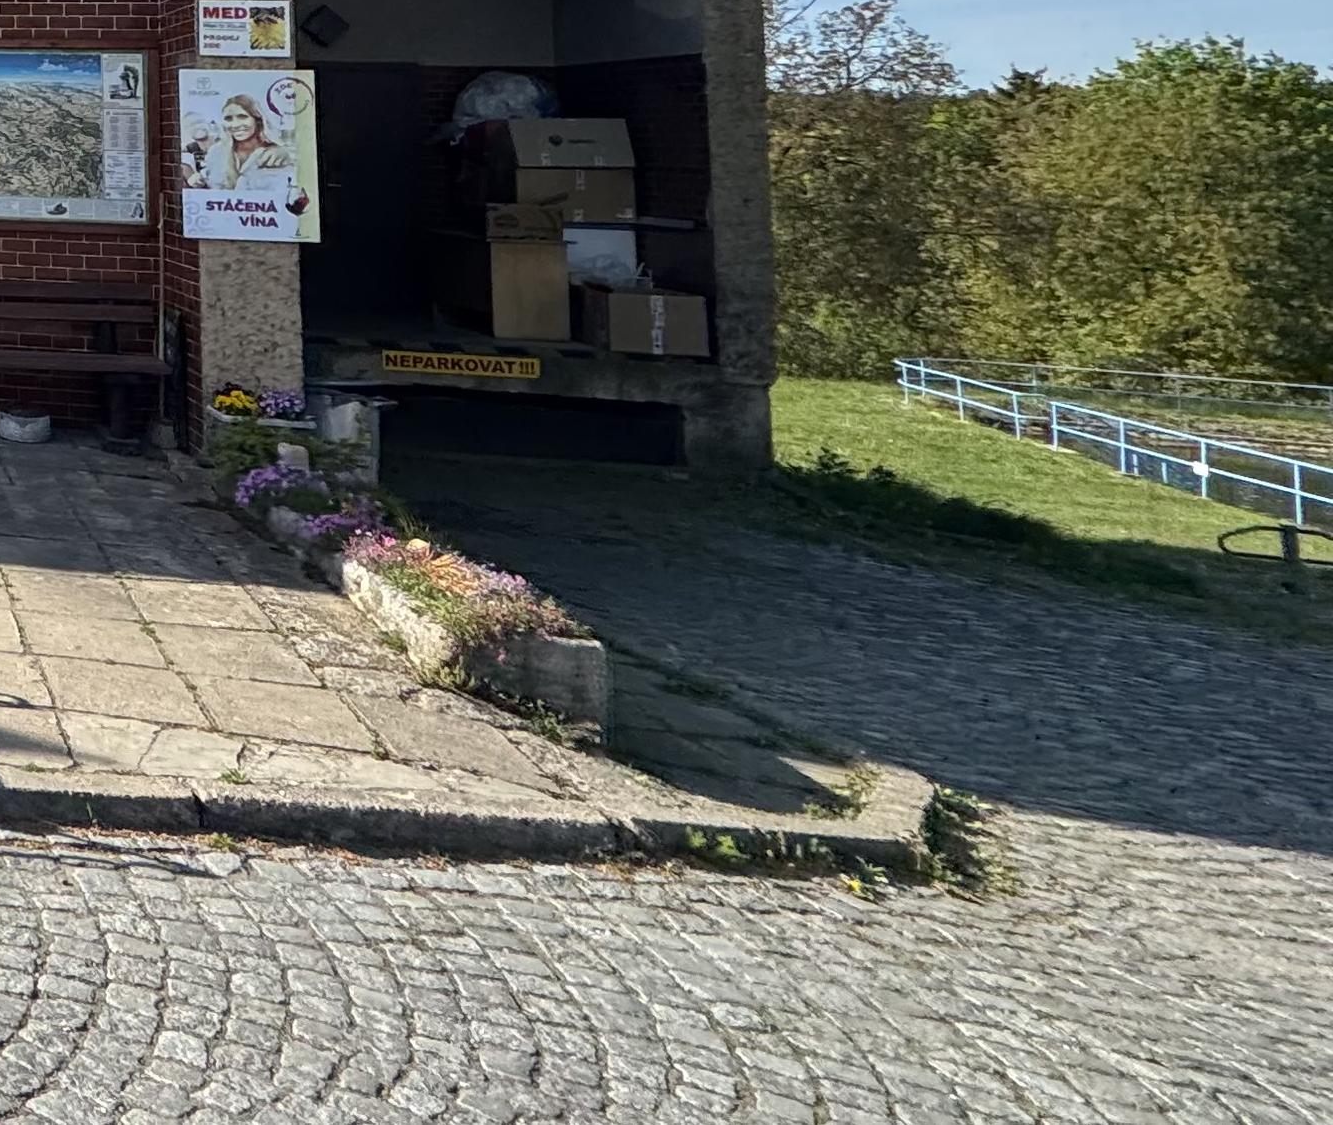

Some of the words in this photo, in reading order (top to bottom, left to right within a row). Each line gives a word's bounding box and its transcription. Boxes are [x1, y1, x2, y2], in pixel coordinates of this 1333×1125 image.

[203, 6, 248, 19] MED
[206, 198, 278, 213] STÁČENÁ
[239, 213, 279, 228] VÍNA
[385, 353, 516, 374] NEPARKOVAT
